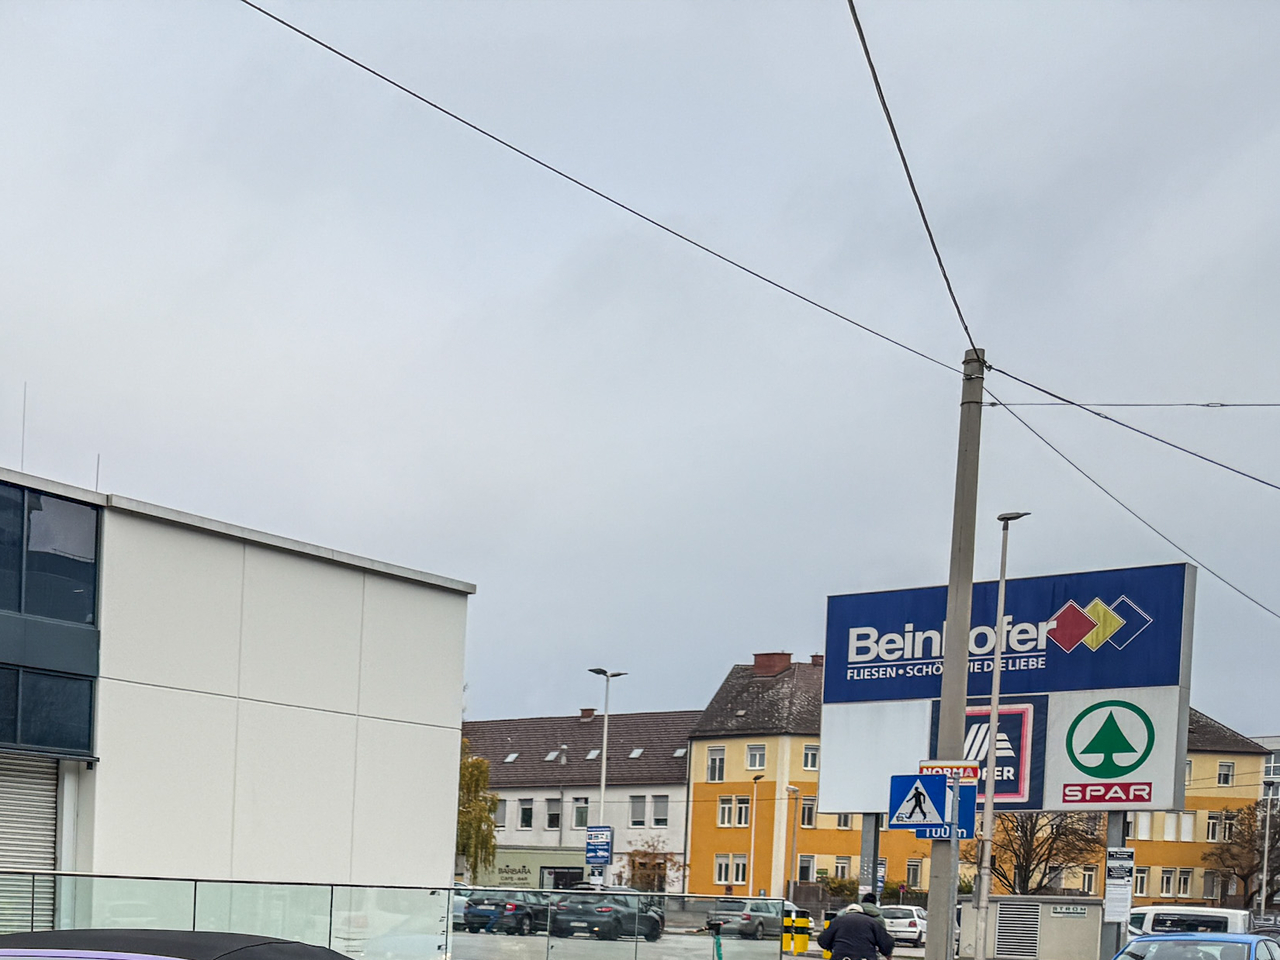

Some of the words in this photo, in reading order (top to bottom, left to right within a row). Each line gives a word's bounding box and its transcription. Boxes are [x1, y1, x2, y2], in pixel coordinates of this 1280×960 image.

[848, 615, 1057, 662] Beinofer
[846, 667, 897, 681] FLIESEN
[905, 662, 943, 677] SCHÖ
[984, 661, 1007, 673] DE
[1008, 658, 1046, 670] LIEBE
[1063, 785, 1150, 802] SPAR
[925, 827, 950, 838] 100
